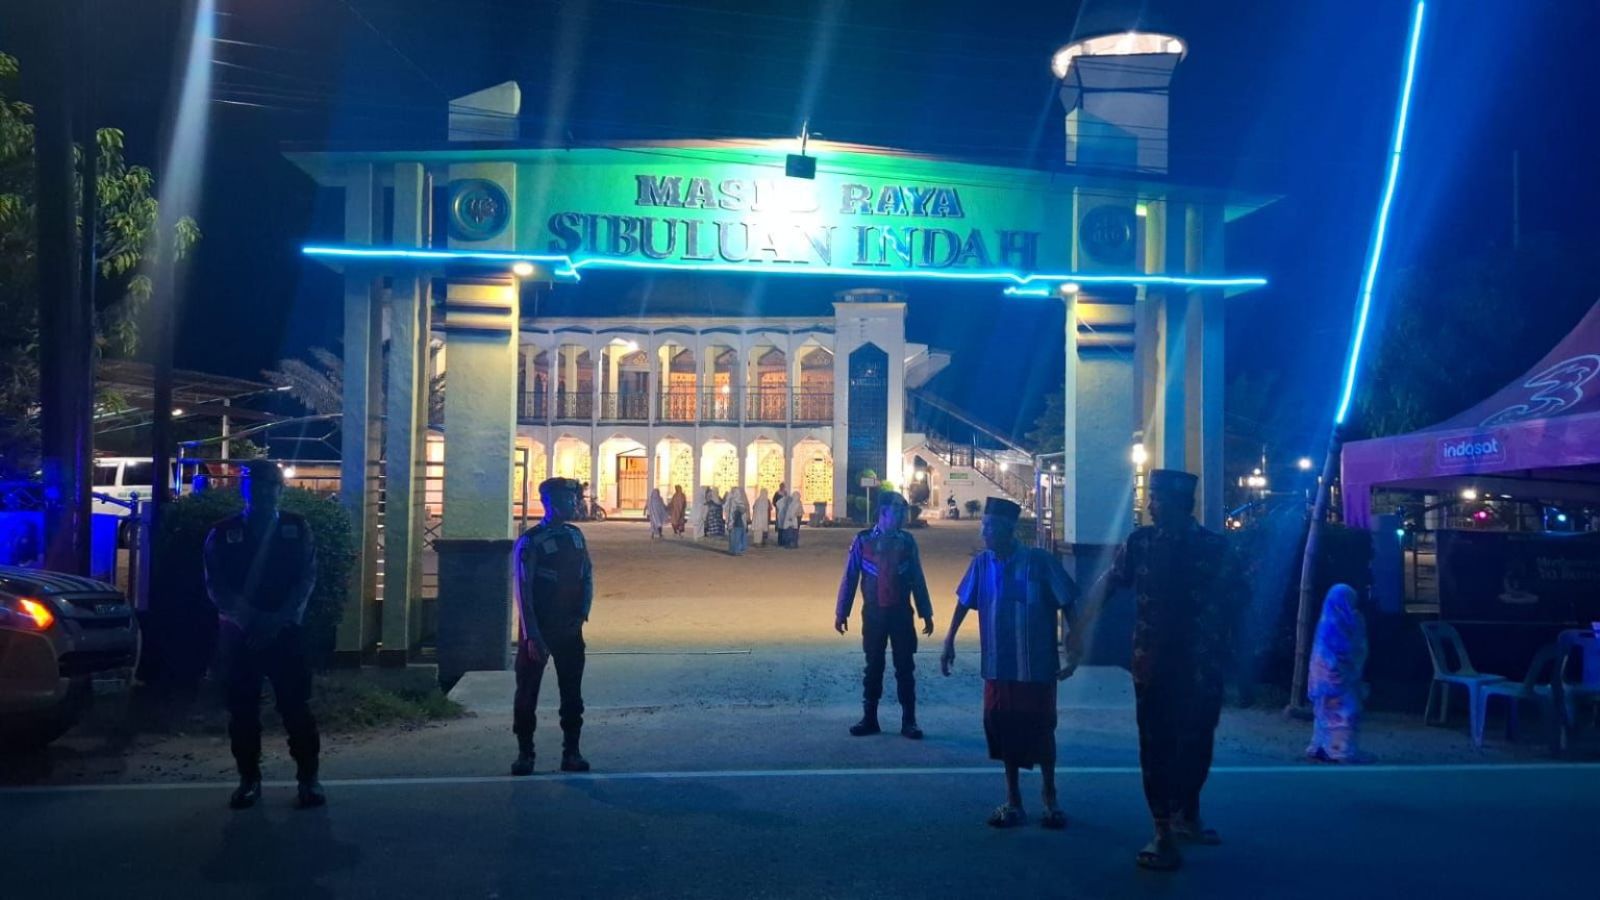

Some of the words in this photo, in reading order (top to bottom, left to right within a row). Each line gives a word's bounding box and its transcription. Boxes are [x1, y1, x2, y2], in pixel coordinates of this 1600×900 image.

[635, 174, 821, 212] MAS
[841, 183, 964, 218] RAYA
[547, 211, 838, 267] SIBULUAN
[851, 225, 1040, 272] INDAH
